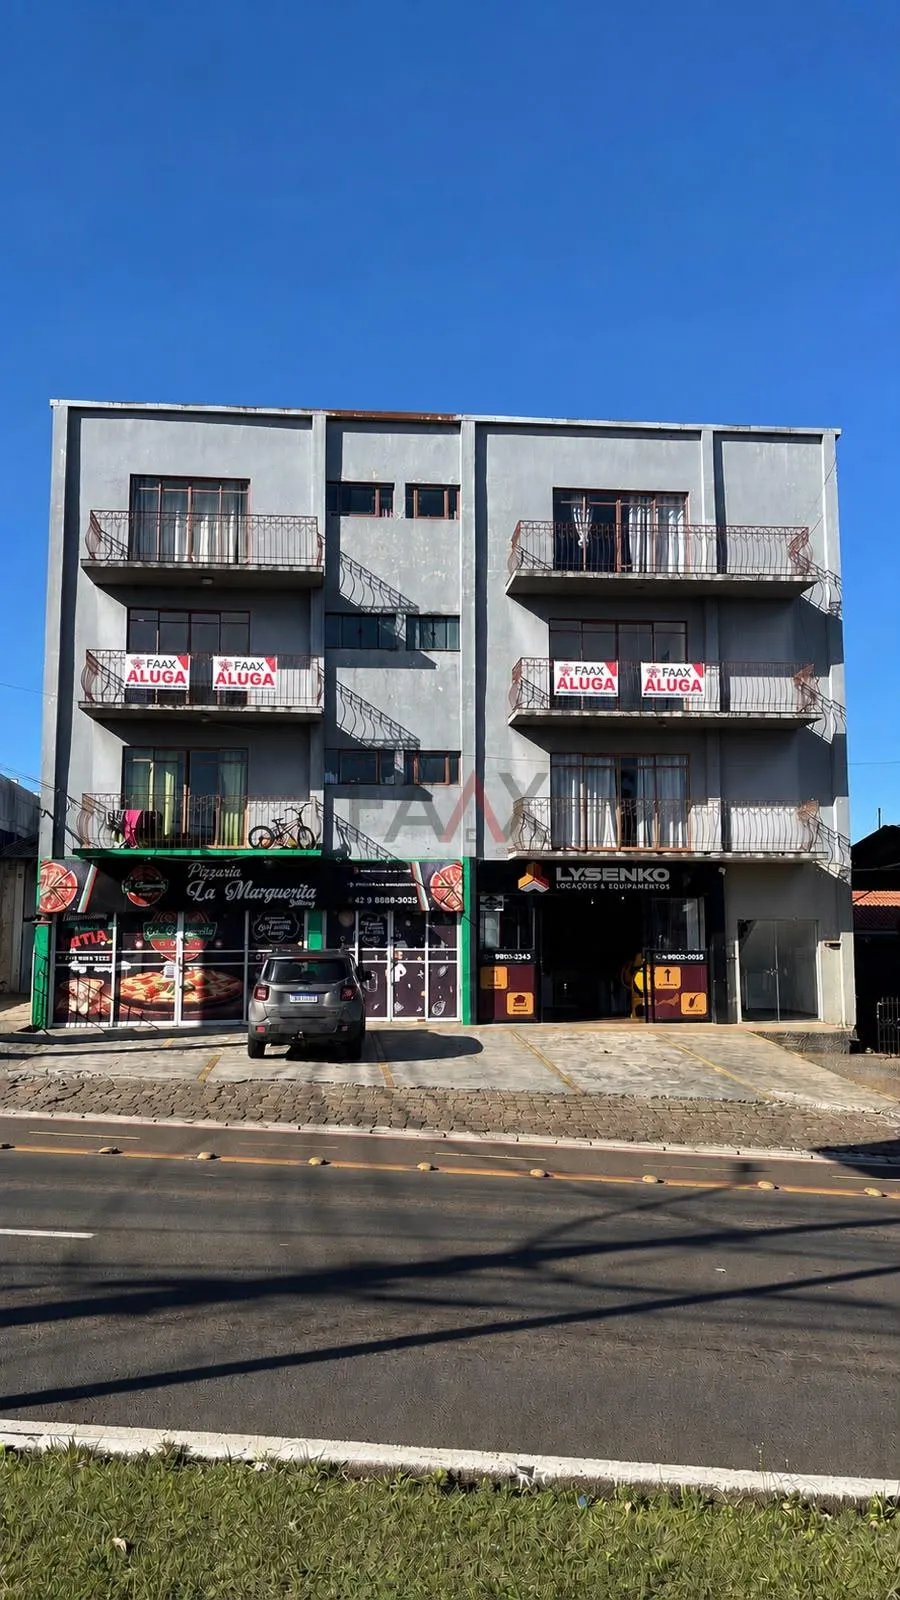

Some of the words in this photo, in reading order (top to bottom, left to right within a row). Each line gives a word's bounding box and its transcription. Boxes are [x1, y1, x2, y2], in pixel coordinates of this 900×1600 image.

[146, 658, 176, 669] FAAX
[234, 661, 265, 671] FAAX
[126, 669, 187, 684] ALUGA
[574, 666, 604, 676] FAAX
[662, 668, 692, 678] FAAX
[215, 672, 275, 686] ALUGA
[556, 677, 616, 691] ALUGA
[644, 678, 703, 692] ALUGA
[187, 862, 242, 880] Pizzaria
[556, 867, 670, 882] LYSENKO
[186, 880, 216, 901] La
[224, 880, 317, 903] Marguerita
[556, 882, 598, 890] LOCAÇÕES
[354, 896, 365, 905] 42
